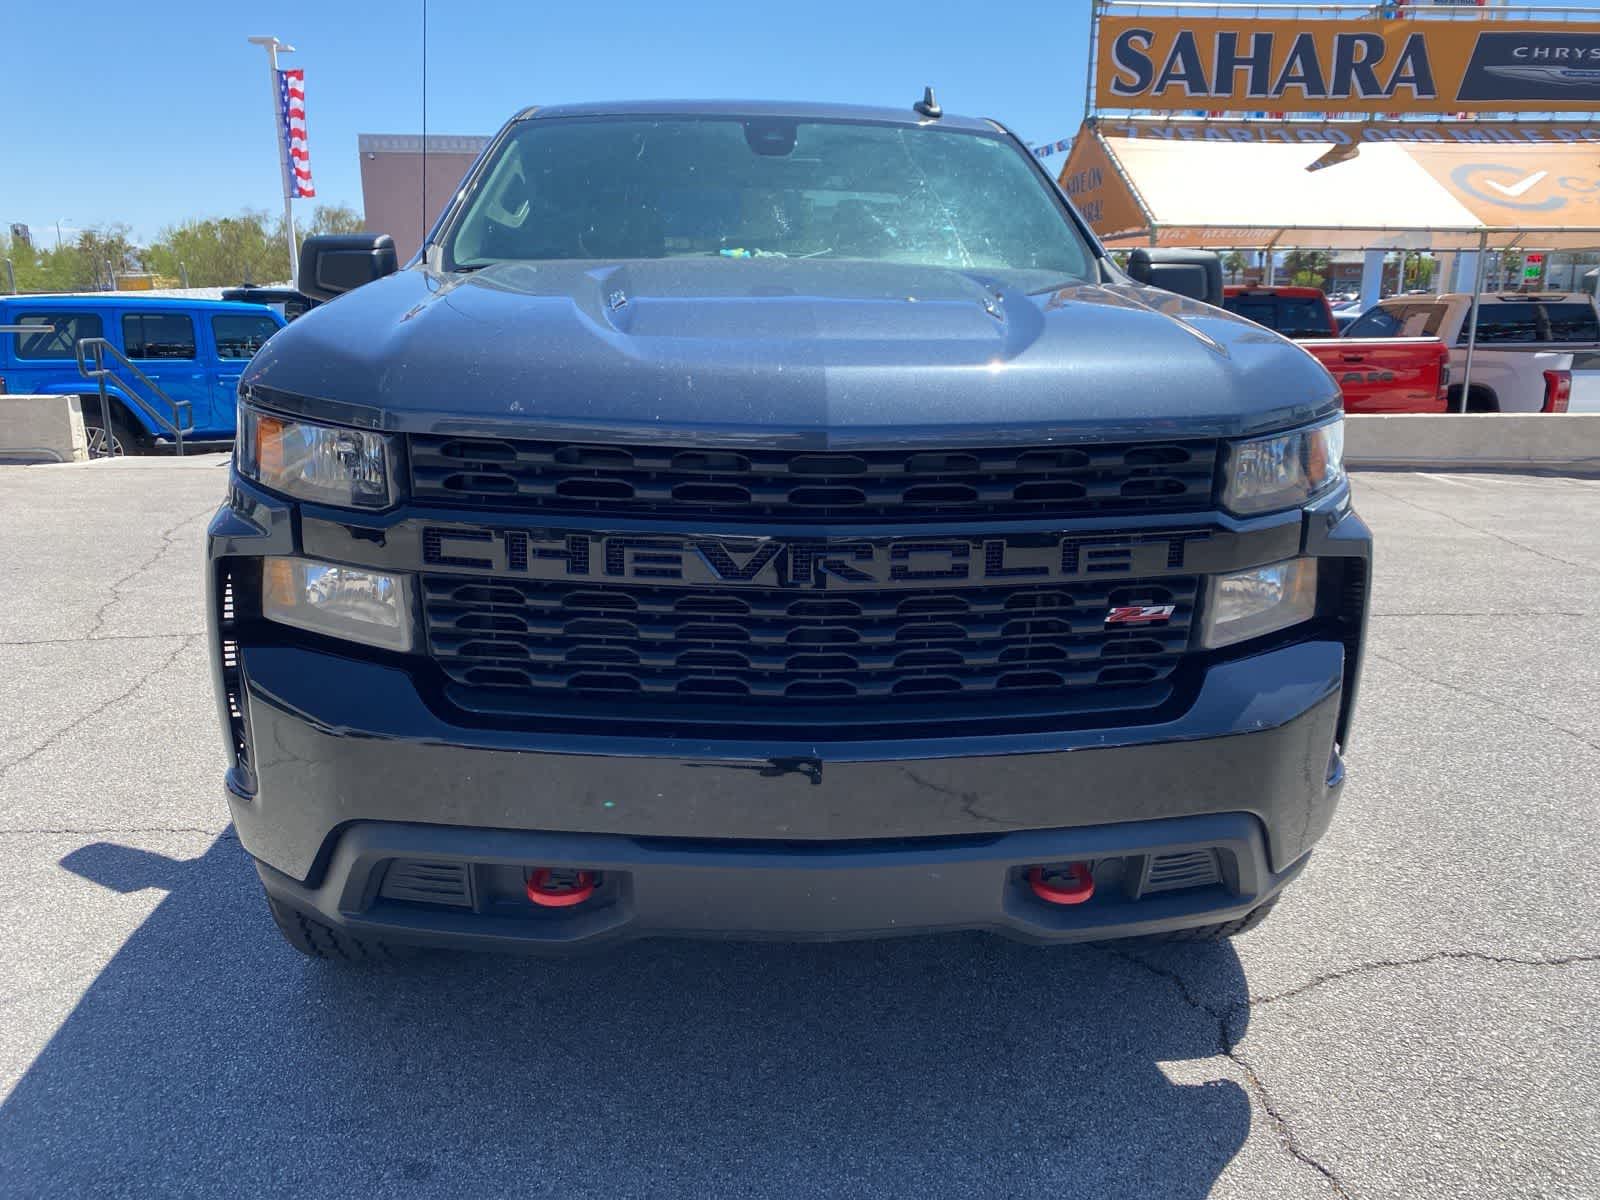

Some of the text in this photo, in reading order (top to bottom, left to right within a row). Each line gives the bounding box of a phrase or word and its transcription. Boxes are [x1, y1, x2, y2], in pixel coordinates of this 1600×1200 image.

[1111, 28, 1439, 100] SAHARA
[1512, 46, 1600, 59] CHRYS
[421, 526, 1212, 584] CHEVROLET
[1104, 605, 1176, 623] Z71
